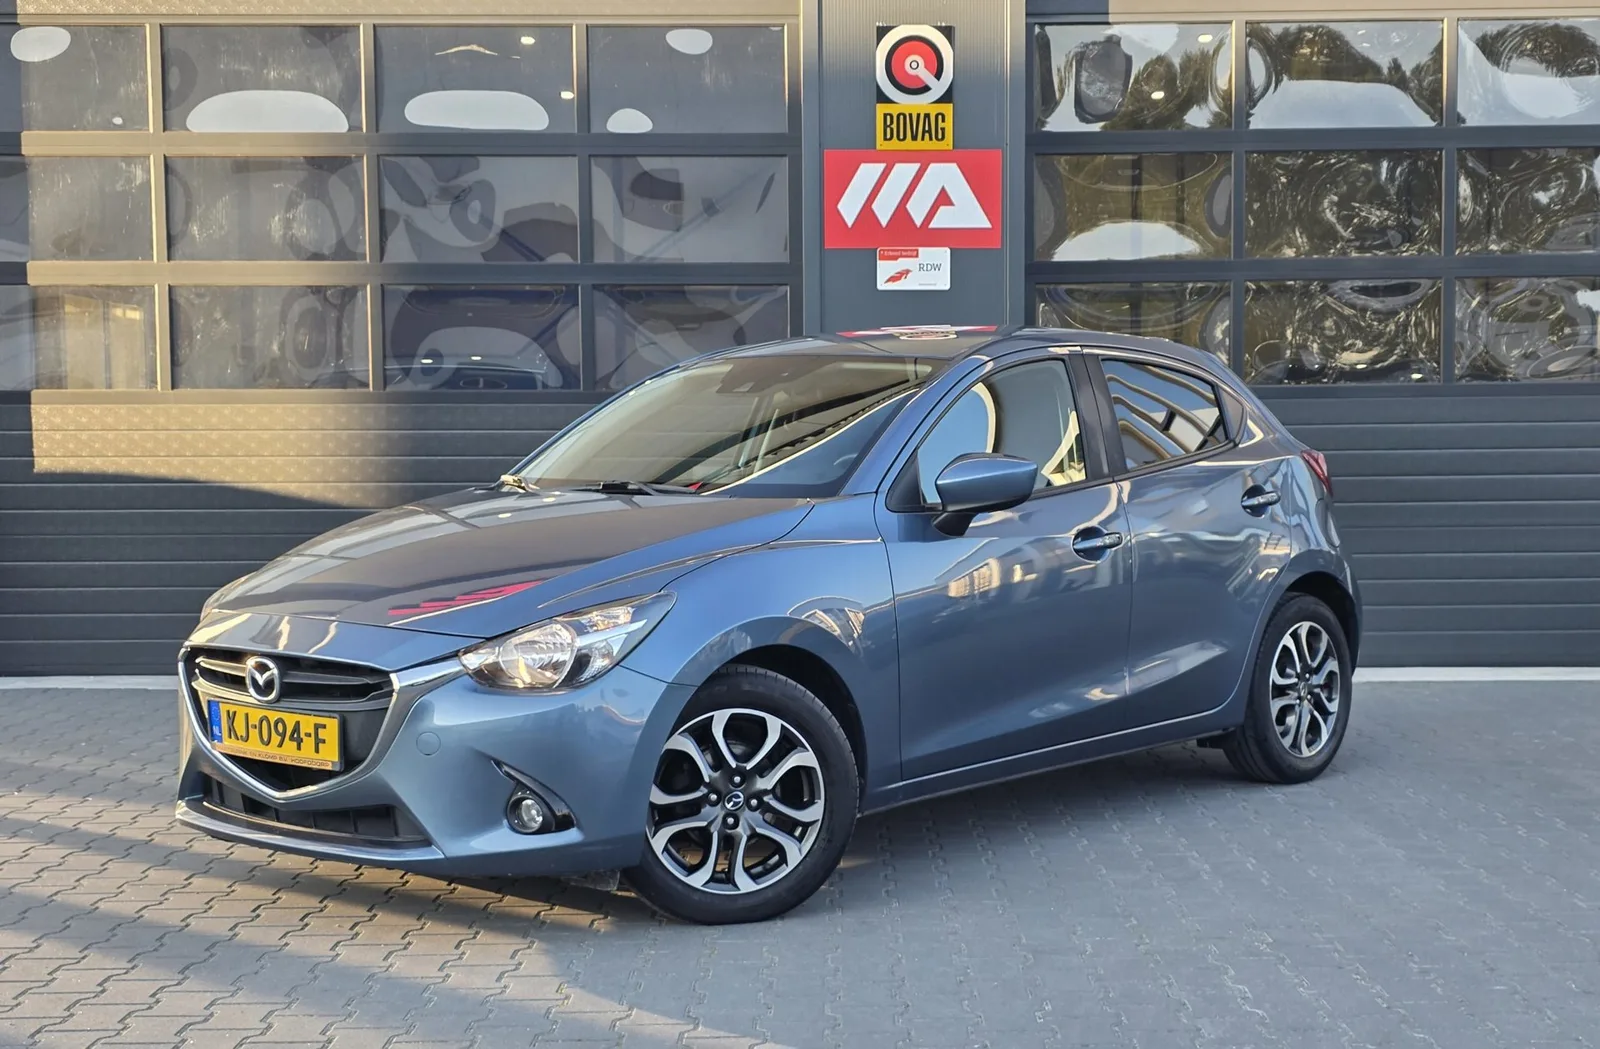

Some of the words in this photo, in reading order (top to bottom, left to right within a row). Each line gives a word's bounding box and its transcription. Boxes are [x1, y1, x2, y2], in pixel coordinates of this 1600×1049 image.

[883, 112, 946, 142] BOVAG
[918, 263, 942, 272] RDW
[213, 725, 221, 736] NL
[226, 709, 327, 754] KJ-094-F
